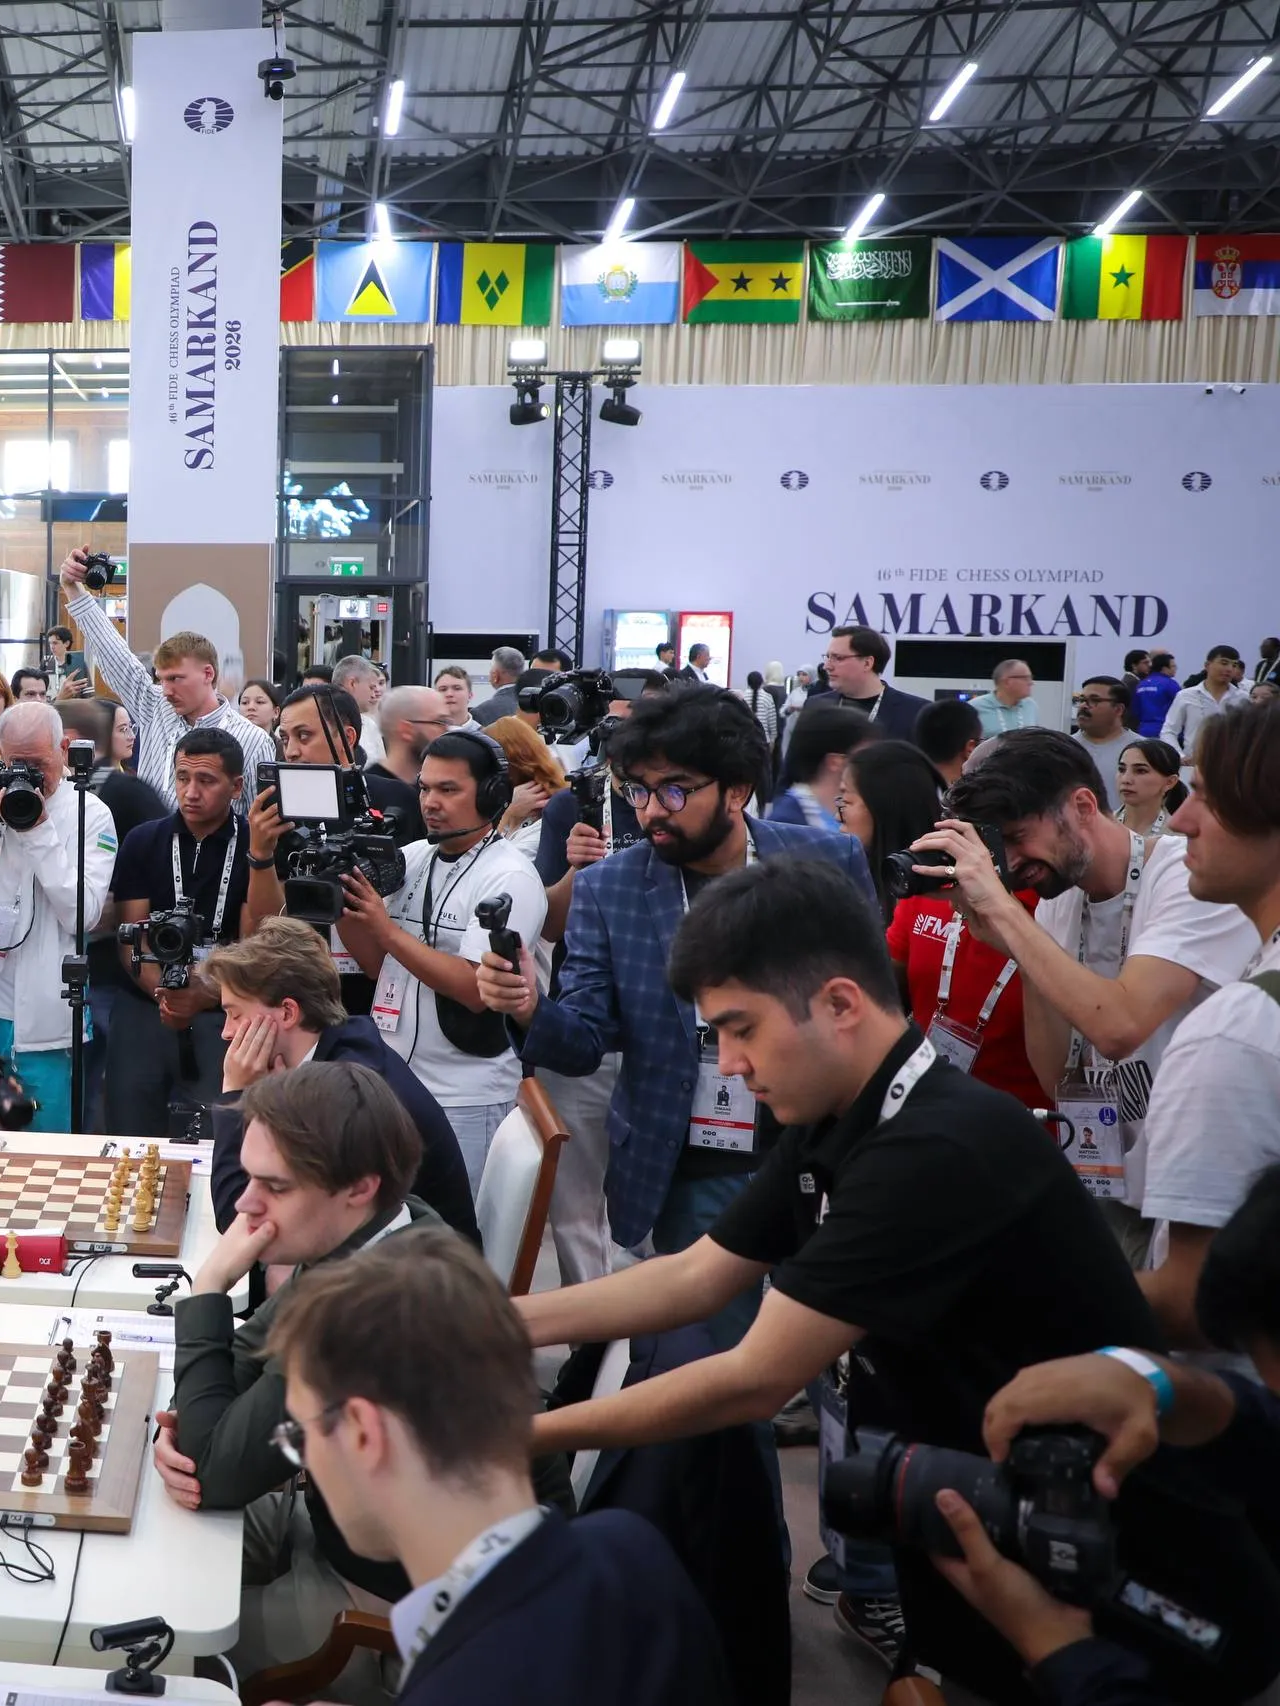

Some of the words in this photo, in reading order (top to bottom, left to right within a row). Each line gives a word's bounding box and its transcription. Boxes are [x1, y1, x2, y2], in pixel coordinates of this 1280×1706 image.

[169, 266, 181, 329] OLYMPIAD
[169, 331, 179, 368] CHESS
[184, 220, 218, 470] SAMARKAND
[224, 320, 242, 371] 2026
[168, 374, 178, 401] FIDE
[468, 473, 539, 484] SAMARKAND
[661, 473, 732, 484] SAMARKAND
[858, 474, 931, 486] SAMARKAND
[1058, 474, 1132, 486] SAMARKAND
[909, 568, 948, 582] FIDE
[956, 568, 1009, 583] CHESS
[1014, 568, 1104, 584] OLYMPIAD
[805, 590, 1169, 638] SAMARKAND
[440, 911, 458, 921] UEL
